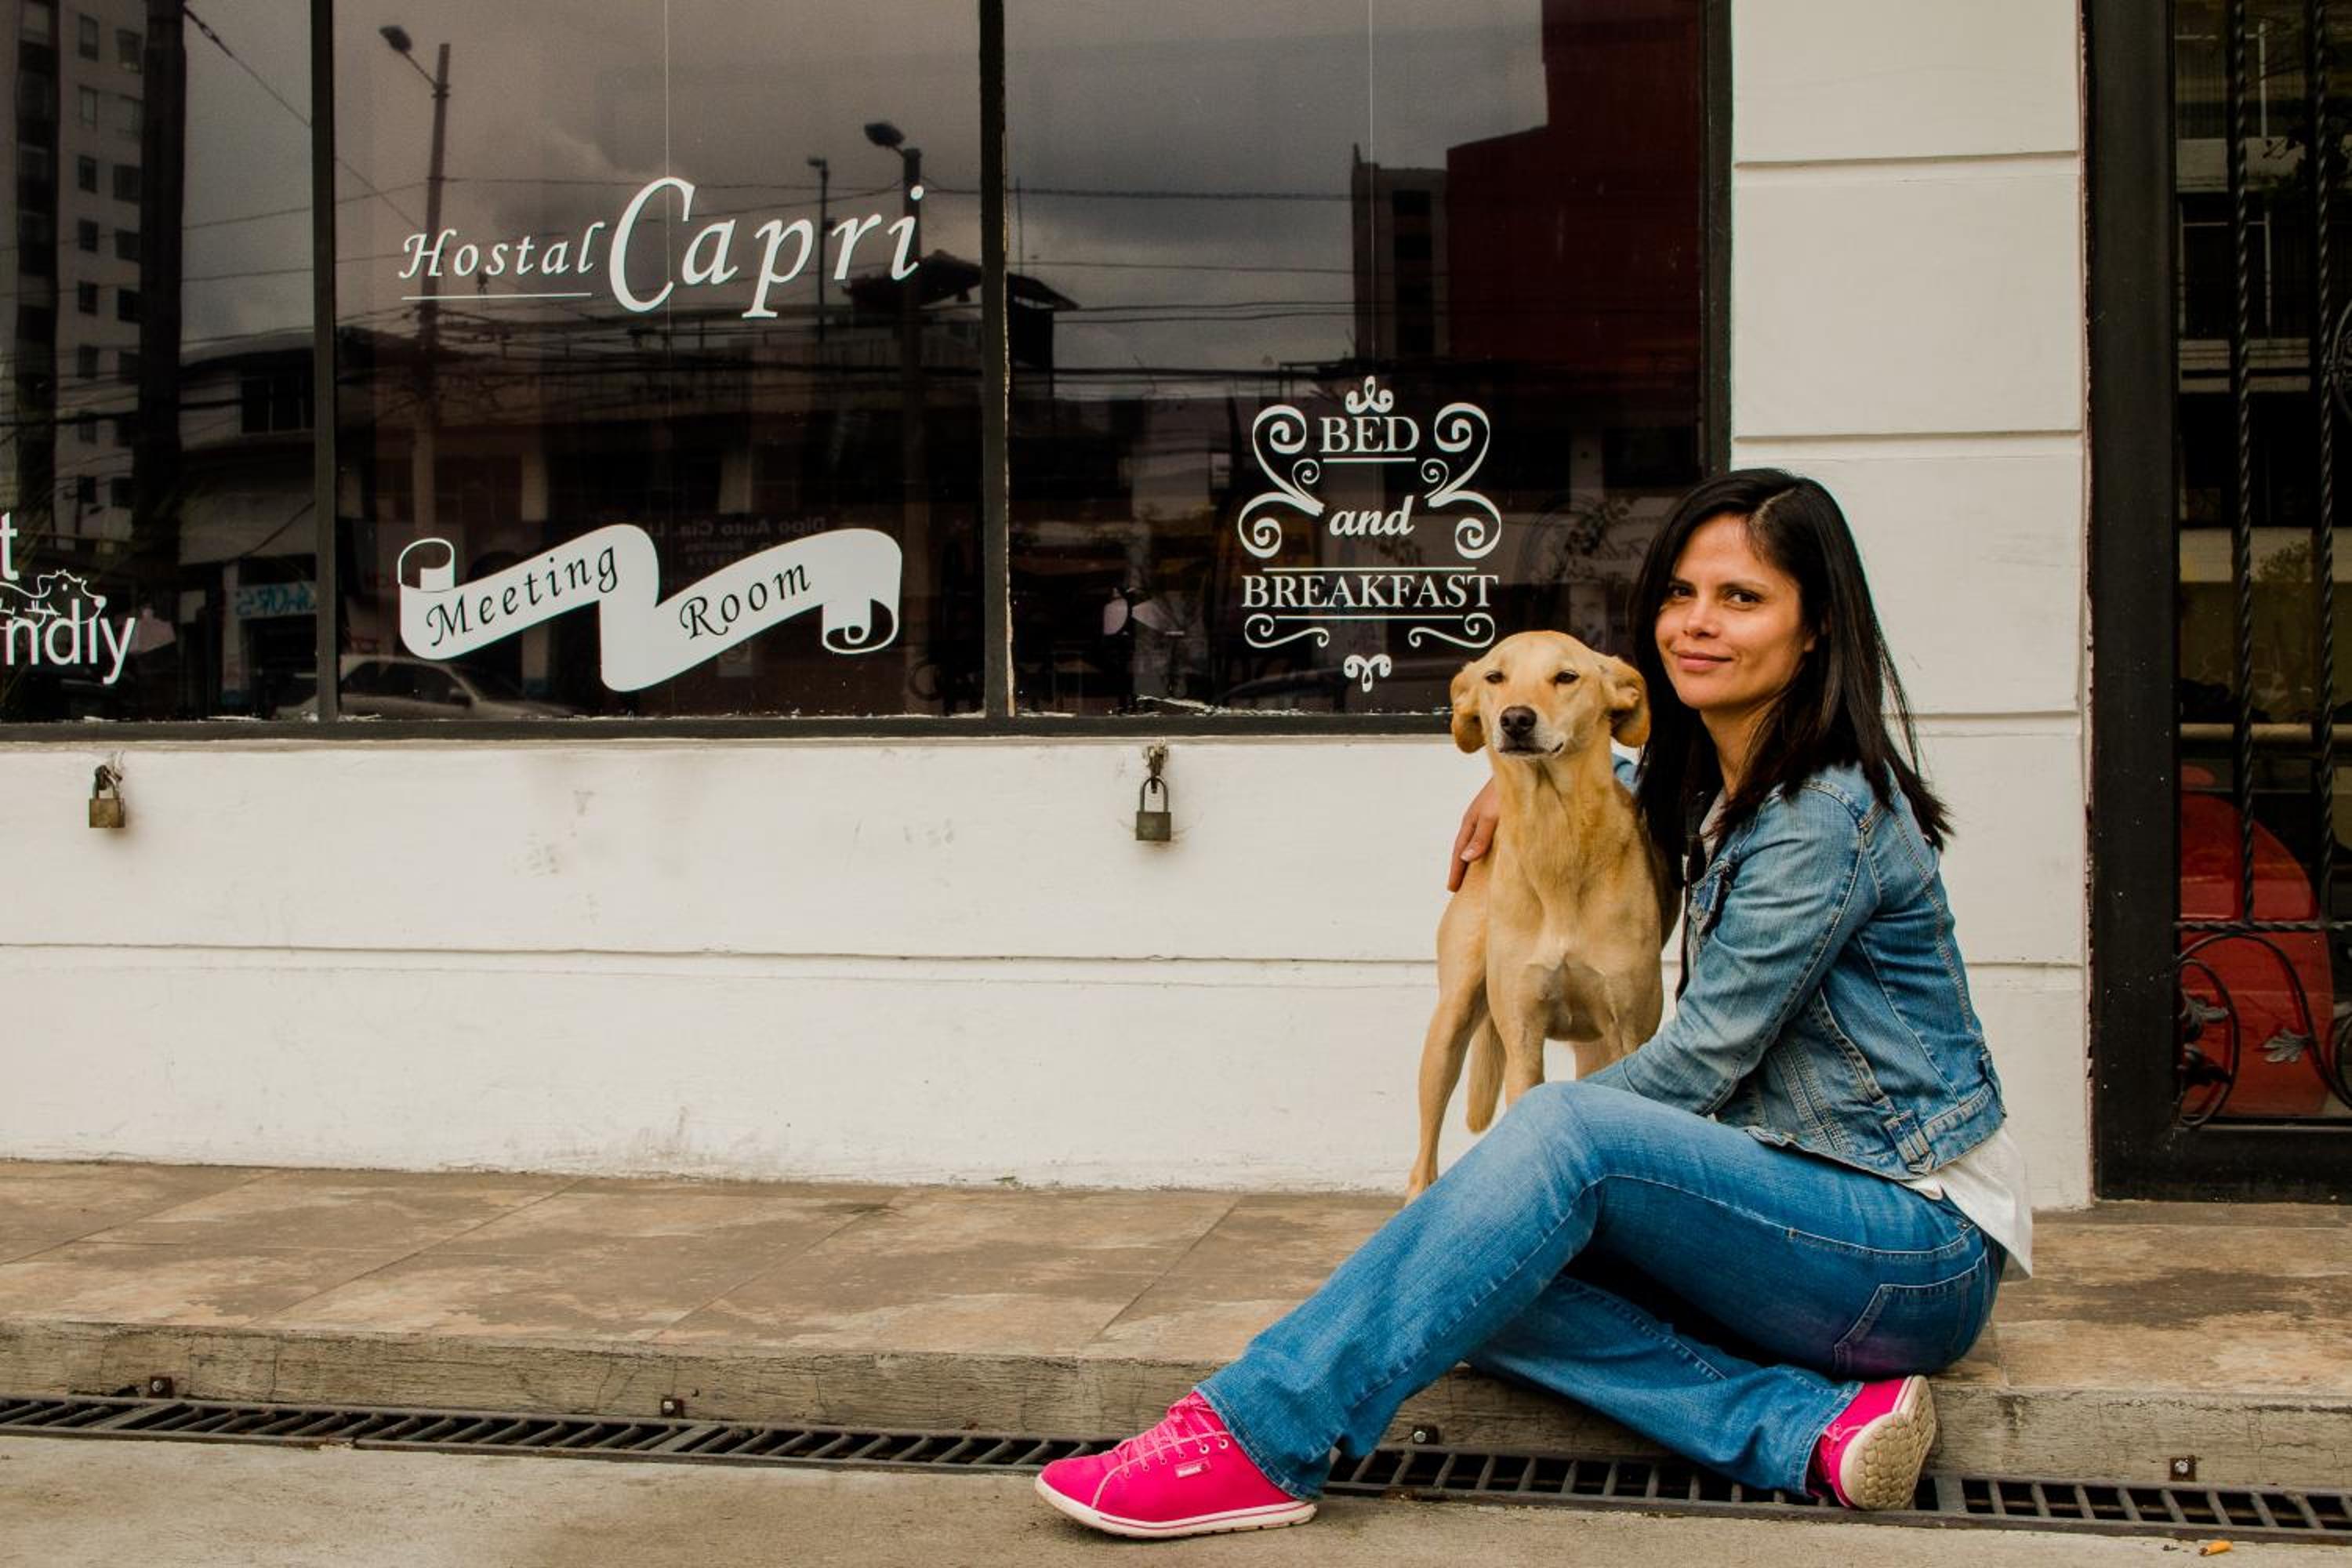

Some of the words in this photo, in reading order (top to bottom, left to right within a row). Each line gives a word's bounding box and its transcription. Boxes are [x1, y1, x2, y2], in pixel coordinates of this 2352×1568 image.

[397, 220, 605, 280] Hostal
[609, 176, 924, 318] Capri
[1319, 416, 1420, 453] BED
[1329, 495, 1415, 536] and
[426, 546, 618, 646] Meeting
[680, 563, 811, 639] Room
[1241, 574, 1499, 608] BREAKFAST
